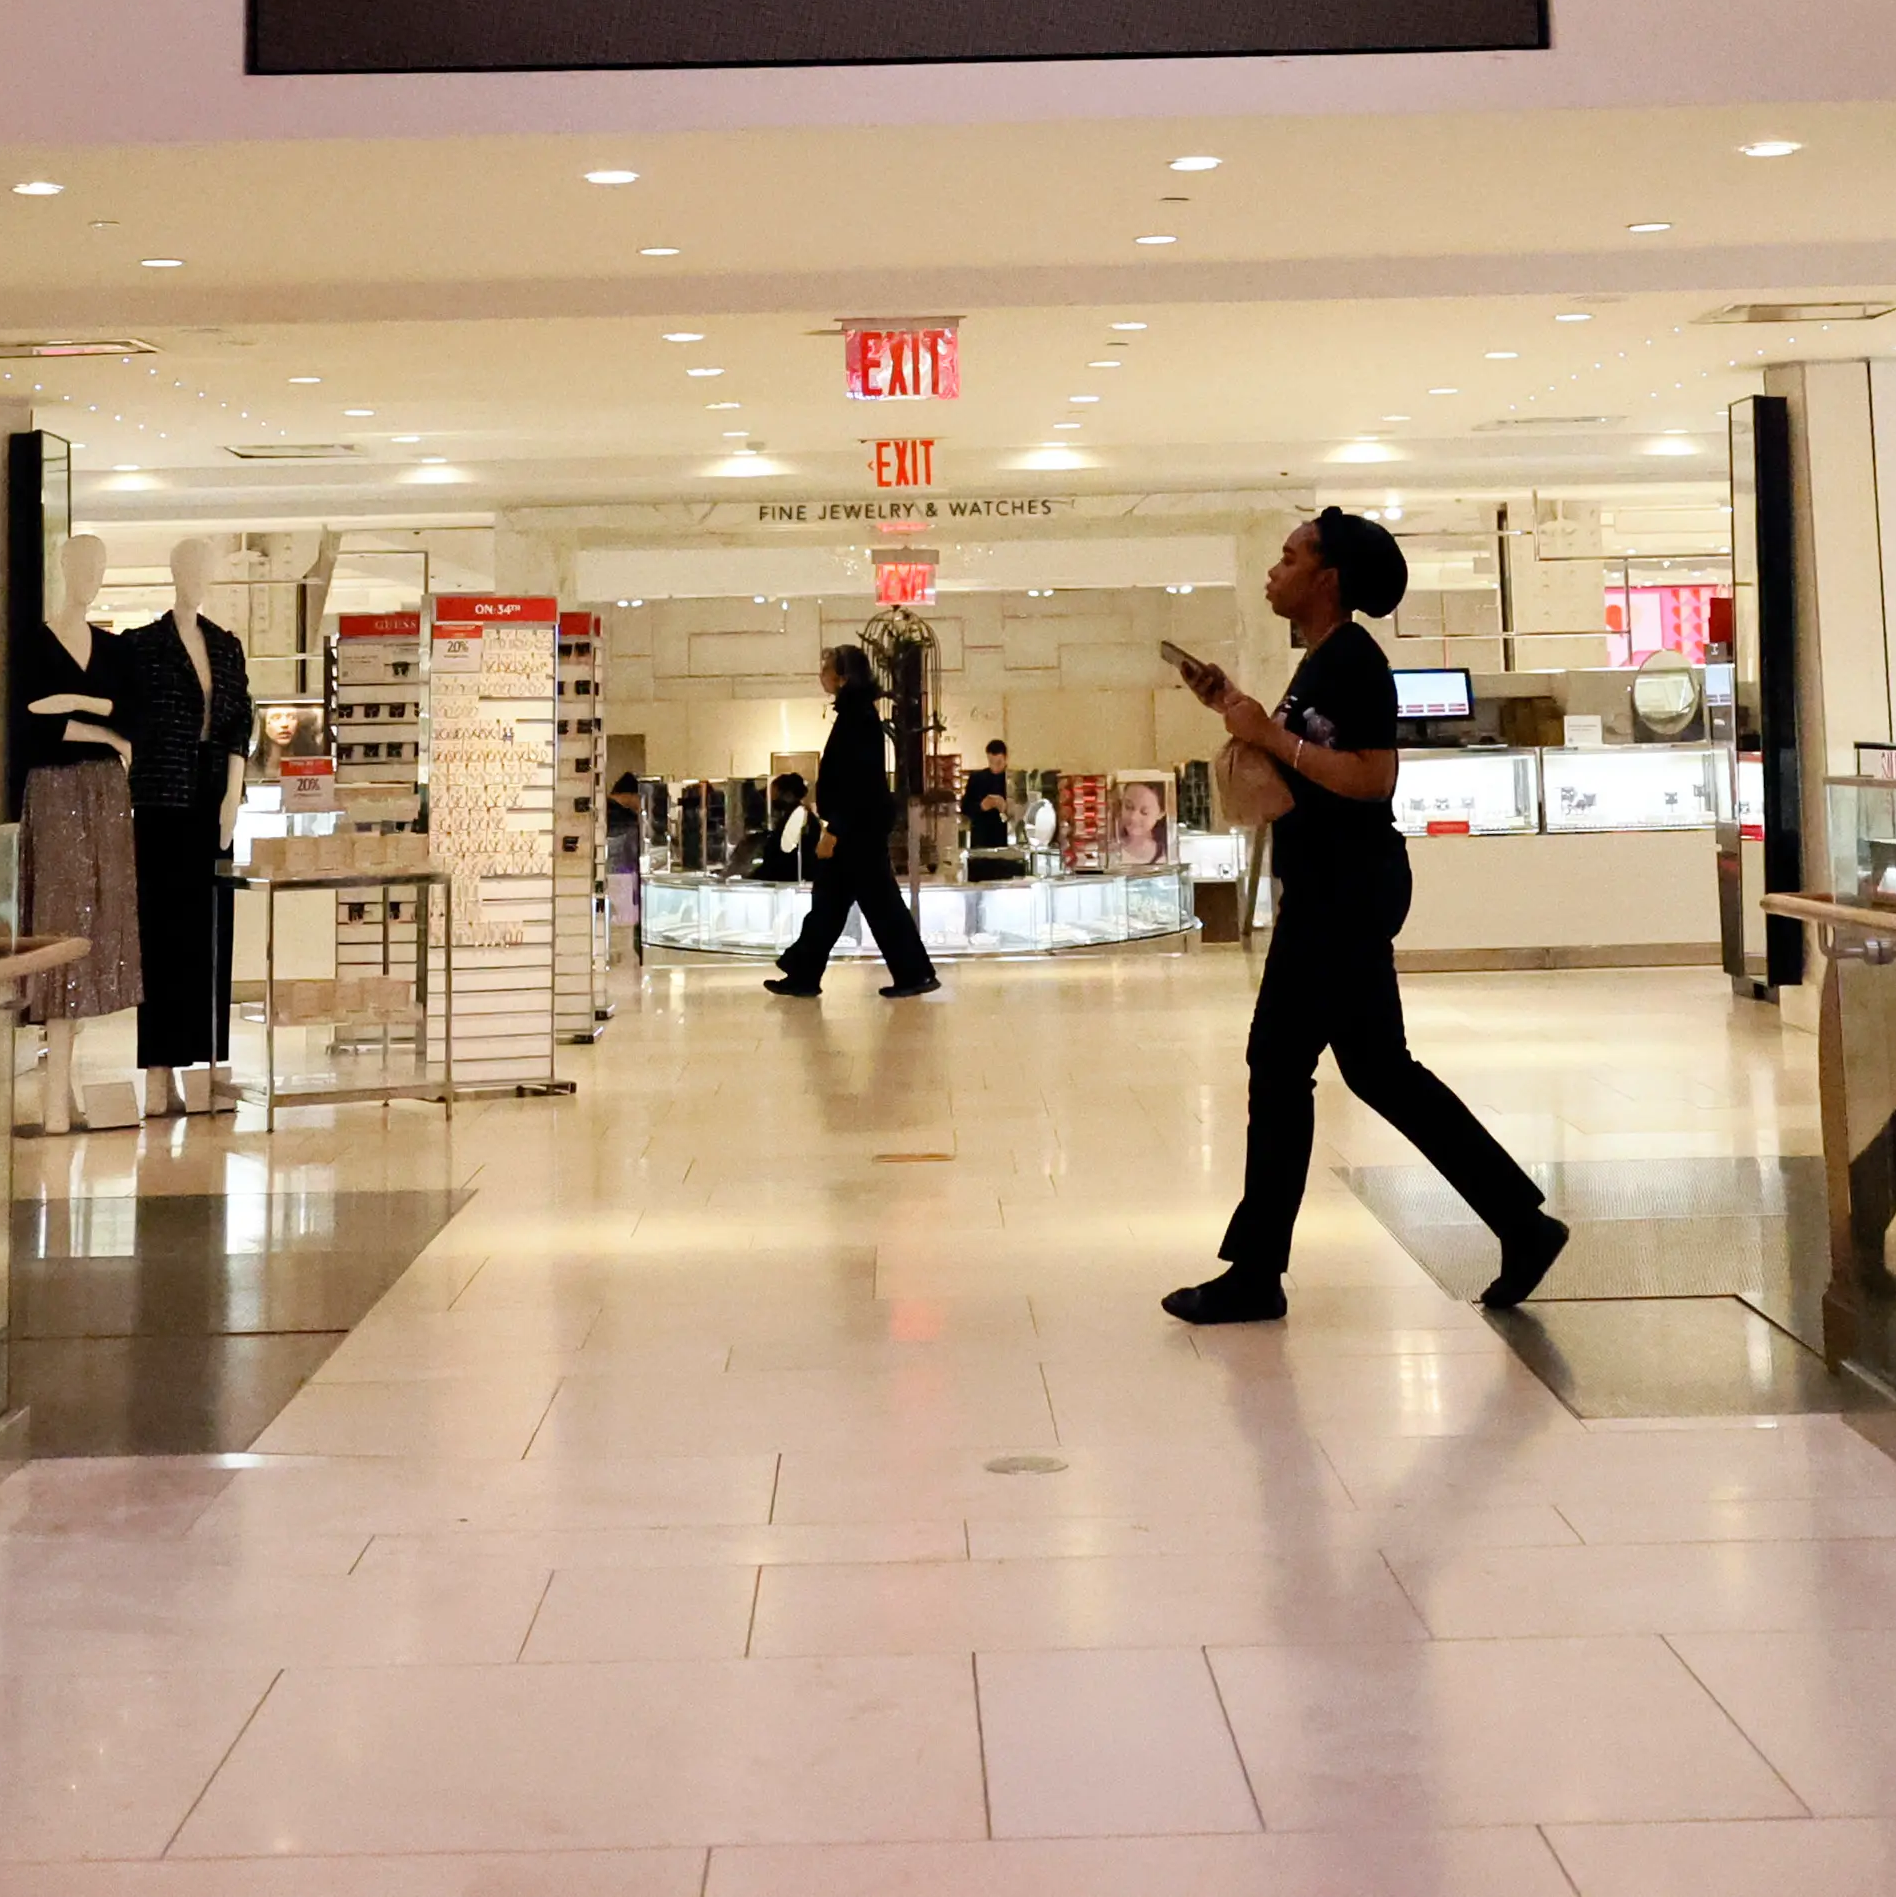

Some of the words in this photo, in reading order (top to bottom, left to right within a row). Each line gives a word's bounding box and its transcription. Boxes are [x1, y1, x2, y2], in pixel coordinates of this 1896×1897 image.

[860, 330, 944, 397] EXIT
[875, 439, 935, 488] EXIT
[759, 504, 807, 522] FINE
[818, 502, 915, 521] JEWELRY
[925, 501, 939, 518] &
[950, 499, 1052, 517] WATCHES
[474, 603, 493, 615] ON
[447, 640, 469, 653] 20%
[296, 778, 321, 791] 20%
